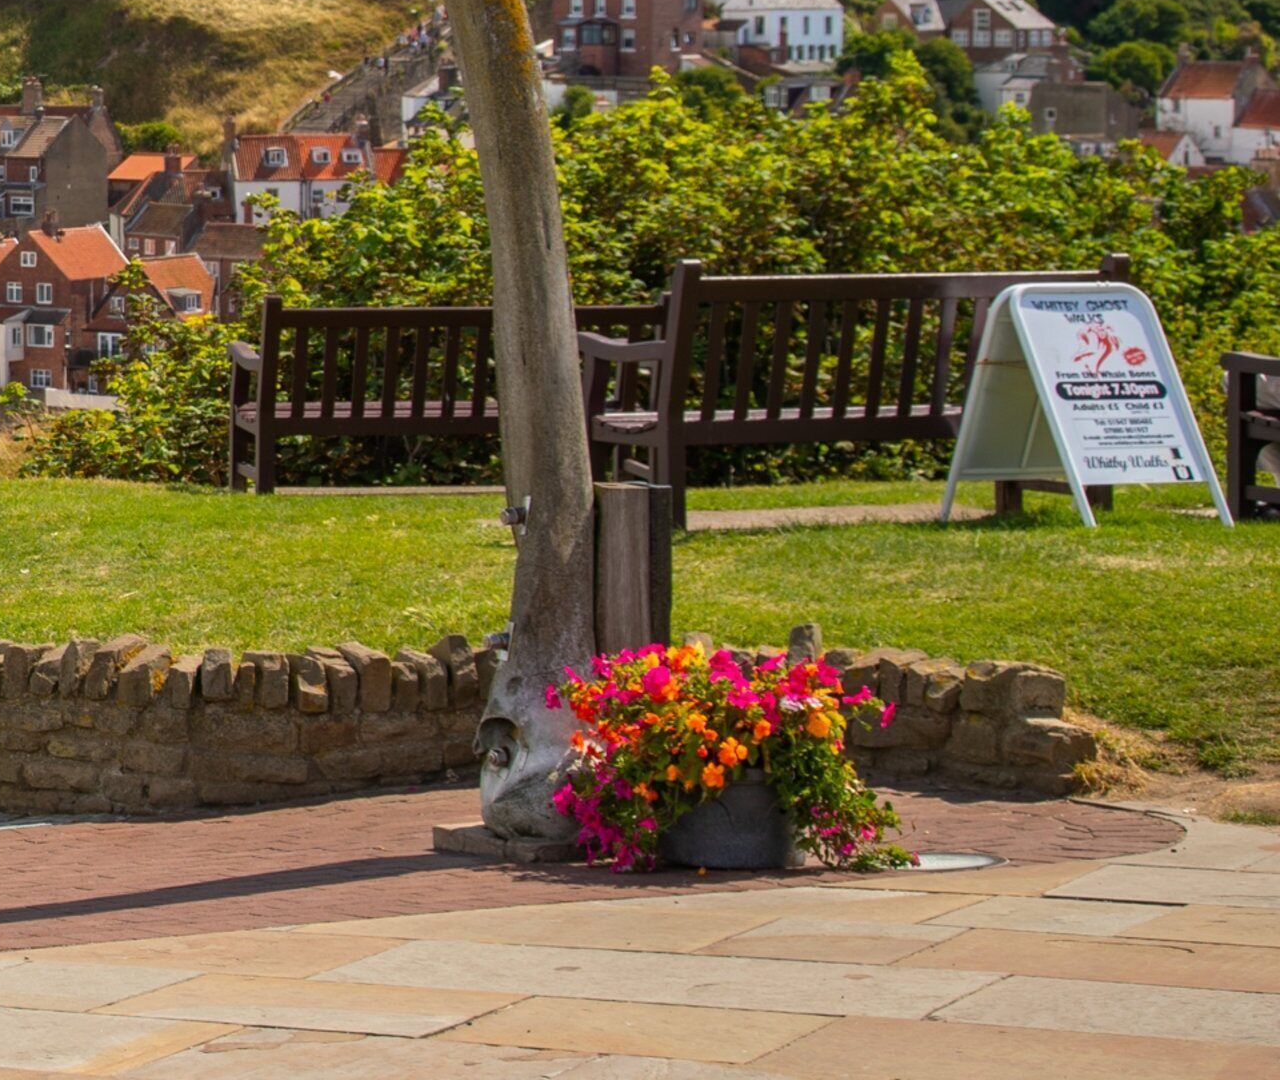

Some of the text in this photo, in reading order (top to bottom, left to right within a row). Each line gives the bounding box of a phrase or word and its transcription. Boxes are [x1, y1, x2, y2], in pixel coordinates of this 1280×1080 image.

[1031, 300, 1128, 312] WHITBY GHOST
[1055, 371, 1080, 379] From
[1101, 370, 1127, 378] Whale
[1129, 369, 1157, 378] Bones
[1062, 382, 1159, 399] Tonight 7.30pm
[1073, 403, 1105, 411] Adults
[1125, 402, 1149, 410] Child
[1083, 454, 1168, 472] Whitby Walks
